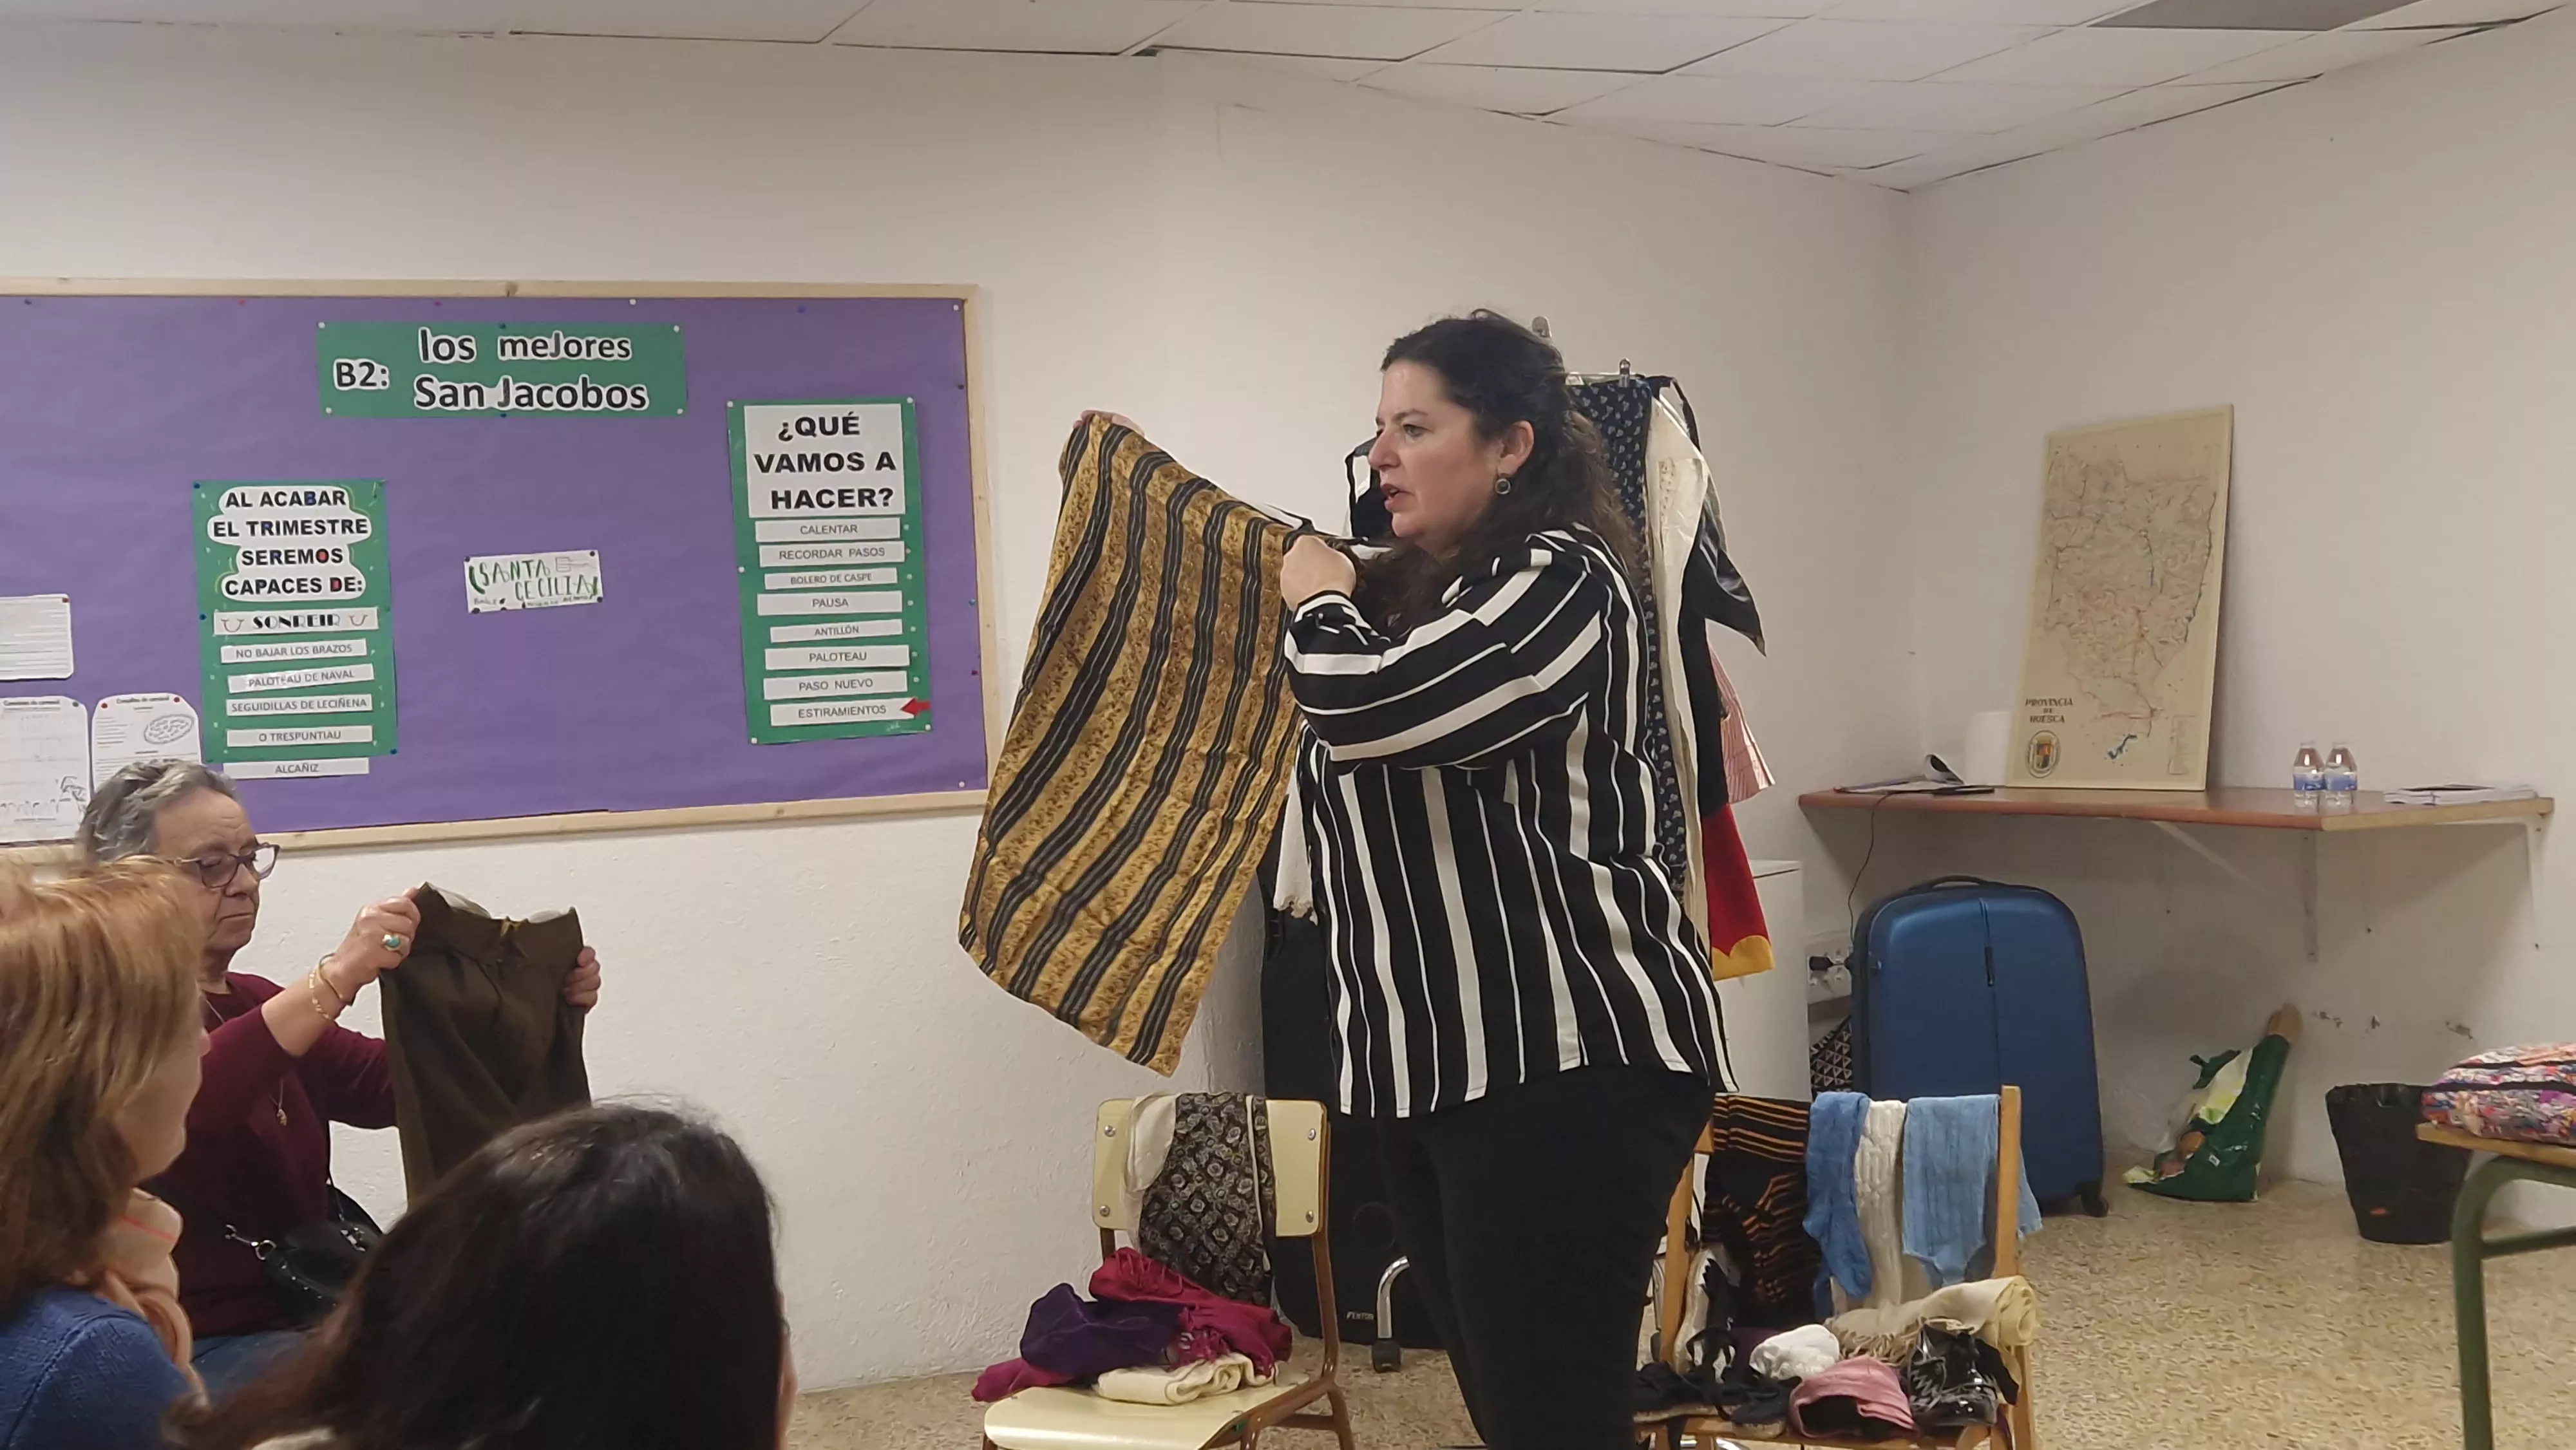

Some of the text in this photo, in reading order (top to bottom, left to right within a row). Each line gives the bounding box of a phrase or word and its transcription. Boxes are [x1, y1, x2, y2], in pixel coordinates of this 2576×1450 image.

[420, 328, 475, 361] los
[336, 361, 388, 388] B2:
[415, 377, 646, 409] San Jacobos
[778, 411, 860, 442] ¿QUÉ
[753, 452, 896, 473] VAMOS A
[225, 491, 346, 507] AL ACABAR
[771, 487, 894, 509] HACER?
[213, 519, 368, 537] EL TRIMESTRE
[800, 524, 858, 535] CALENTAR
[242, 548, 343, 566] SEREMOS
[779, 547, 886, 560] RECORDAR PASOS
[479, 558, 551, 586] SANTA
[790, 573, 872, 585] BOLERO DE CASPE
[225, 576, 362, 596] CAPACES DE:
[812, 598, 849, 608] PAUSA
[252, 614, 341, 630] SONREIR
[815, 625, 859, 636] ANTILLÓN
[236, 645, 352, 659] NO BAJAR LOS BRAZOS
[809, 652, 867, 663] PALOTEAU
[249, 670, 355, 688] PALOTEAU DE NAVAL
[799, 678, 873, 692] PASO NUEVO
[232, 698, 367, 712] SEGUIDILLAS DE LECIÑENA
[798, 705, 887, 719] ESTIRAMIENTOS
[259, 731, 341, 742] O TRESPUNTIAU
[274, 763, 320, 774] ALCAÑIZ
